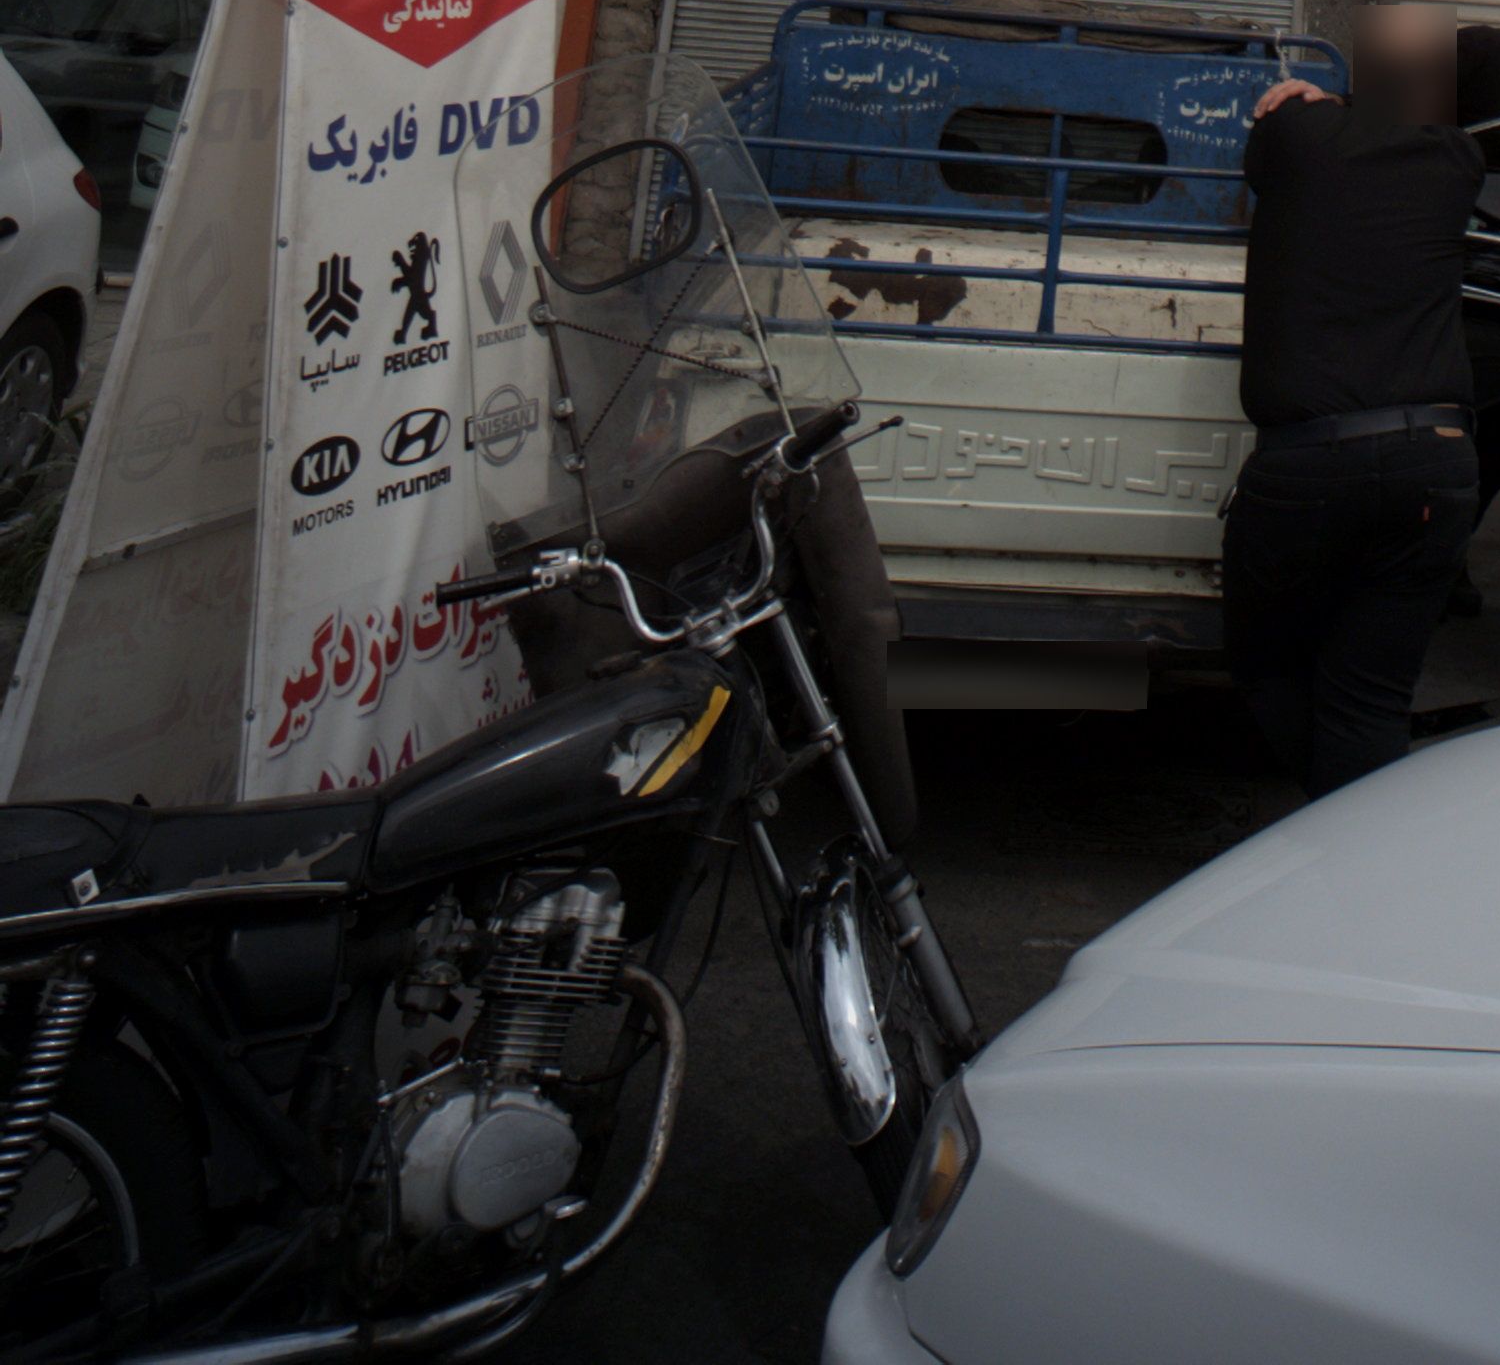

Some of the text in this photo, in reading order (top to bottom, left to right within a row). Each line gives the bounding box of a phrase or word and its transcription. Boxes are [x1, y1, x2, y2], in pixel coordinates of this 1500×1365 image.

[823, 62, 885, 92] اسپرت
[887, 65, 939, 96] ایران
[1179, 97, 1239, 126] اسپرت
[306, 94, 541, 185] DVD فابریک
[299, 348, 361, 393] سایپا
[383, 340, 450, 378] PEUGEOT
[476, 408, 532, 439] NISSAN
[377, 464, 452, 509] HYUNDAI
[292, 498, 355, 537] MOTORS
[268, 602, 404, 750] دزدگیر
